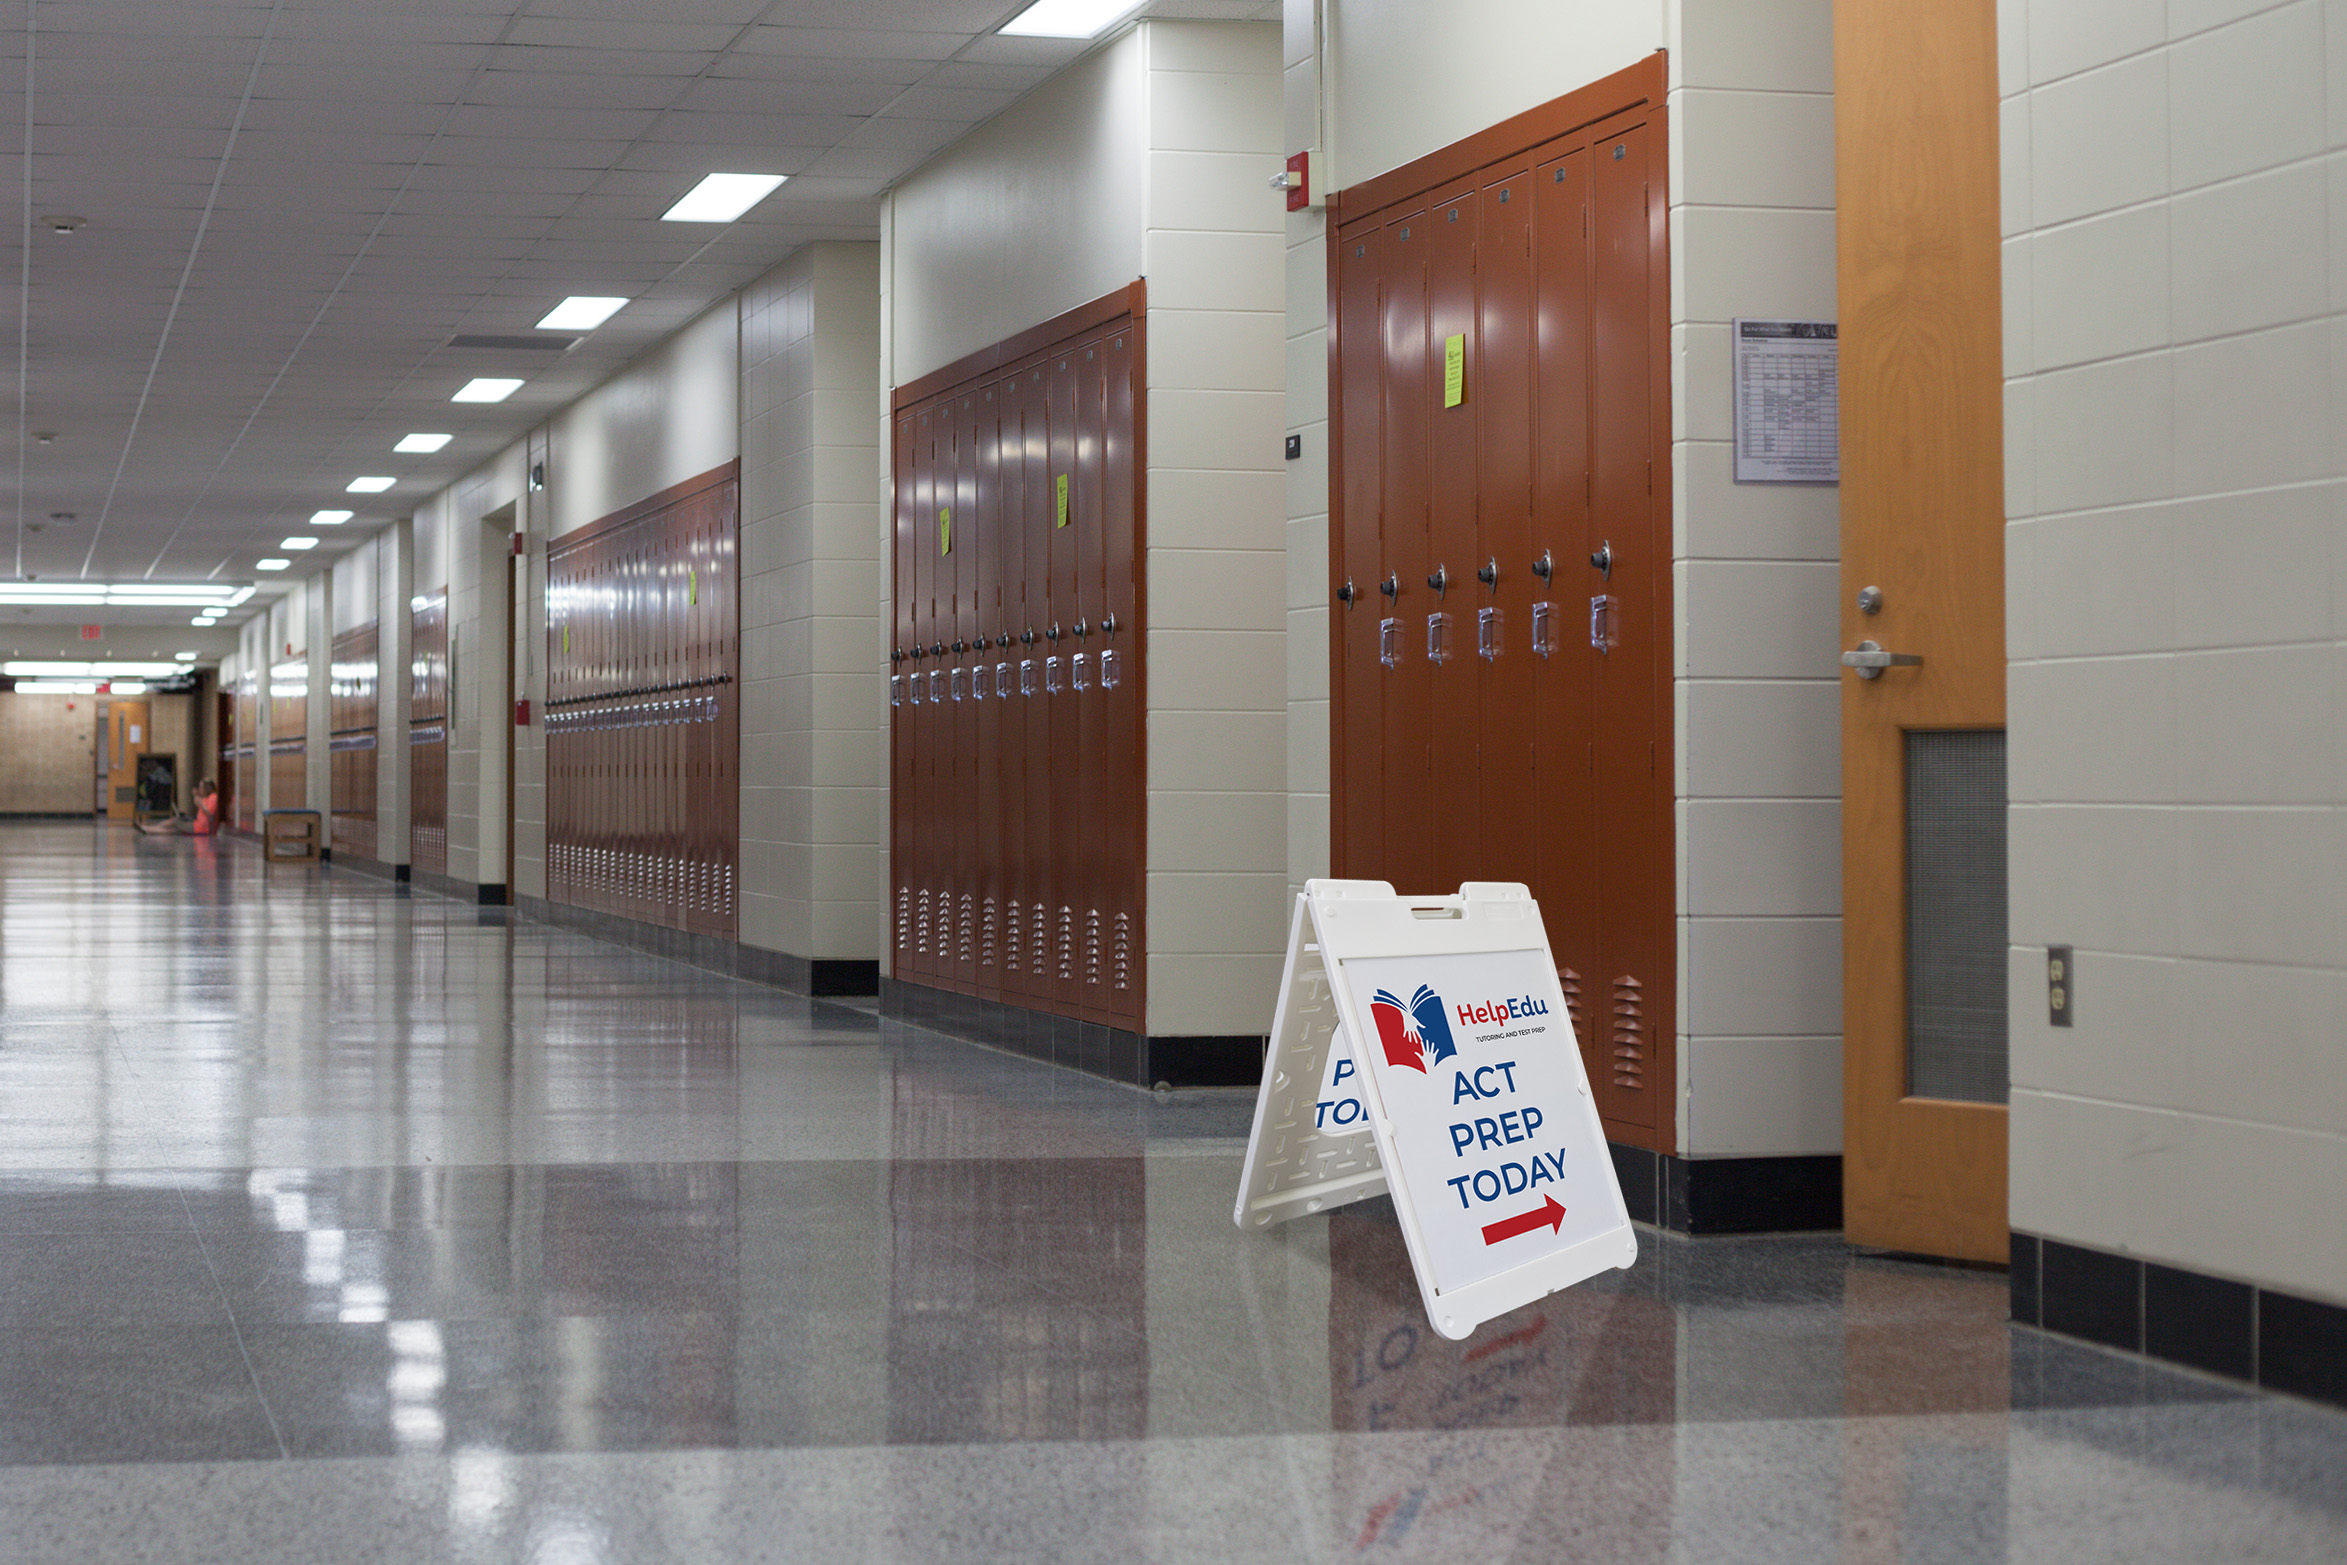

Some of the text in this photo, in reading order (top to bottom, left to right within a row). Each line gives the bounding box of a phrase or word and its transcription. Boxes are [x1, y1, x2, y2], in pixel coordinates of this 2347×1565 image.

[1457, 995, 1549, 1027] HelpEdu
[1475, 1026, 1546, 1043] TUTORING AND TEST PREP
[1332, 1059, 1355, 1086] P
[1453, 1061, 1516, 1105] ACT
[1316, 1098, 1369, 1129] TO
[1449, 1107, 1543, 1157] PREP
[1447, 1148, 1565, 1209] TODAY
